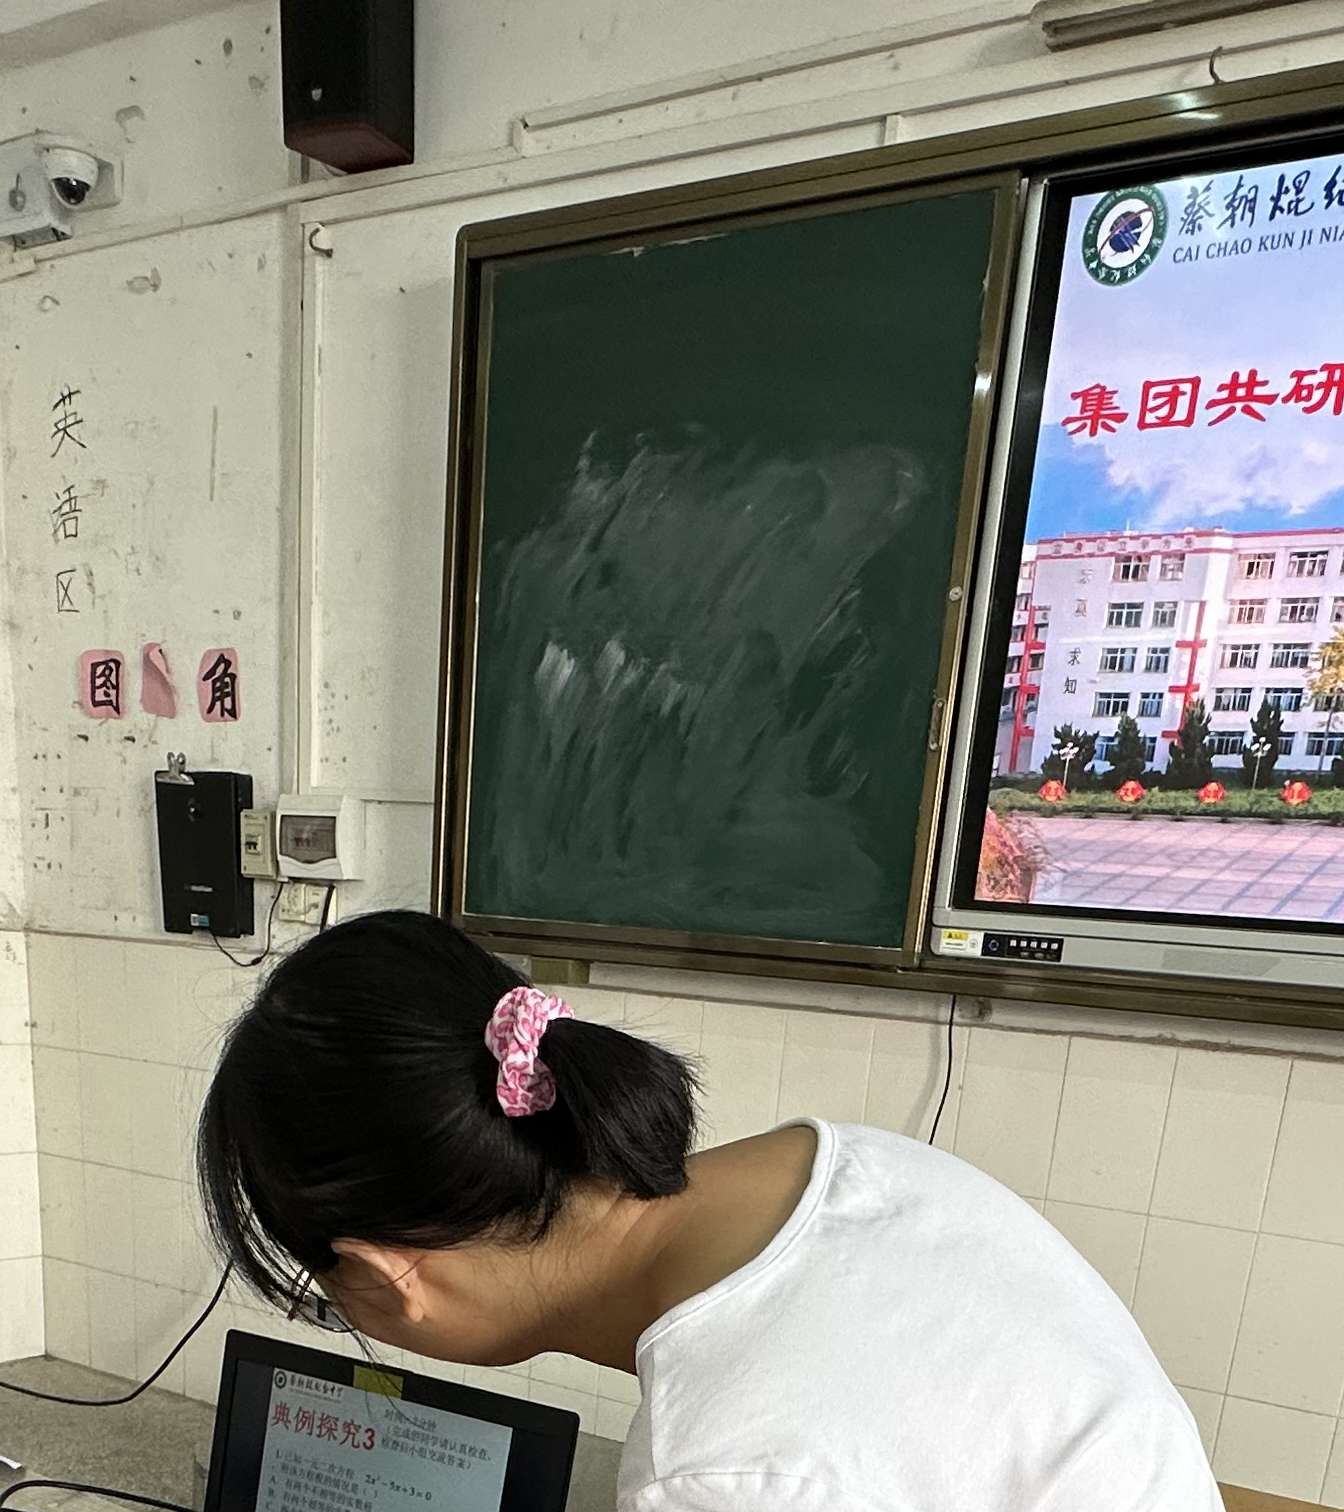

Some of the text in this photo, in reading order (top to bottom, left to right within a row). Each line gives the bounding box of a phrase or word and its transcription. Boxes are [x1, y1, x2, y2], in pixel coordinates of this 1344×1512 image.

[1172, 244, 1201, 264] CAI
[1205, 238, 1253, 260] CHAO
[1256, 231, 1297, 253] KUN
[1298, 228, 1317, 251] JI
[50, 383, 87, 614] 英语区
[271, 1402, 376, 1451] 典例探究3
